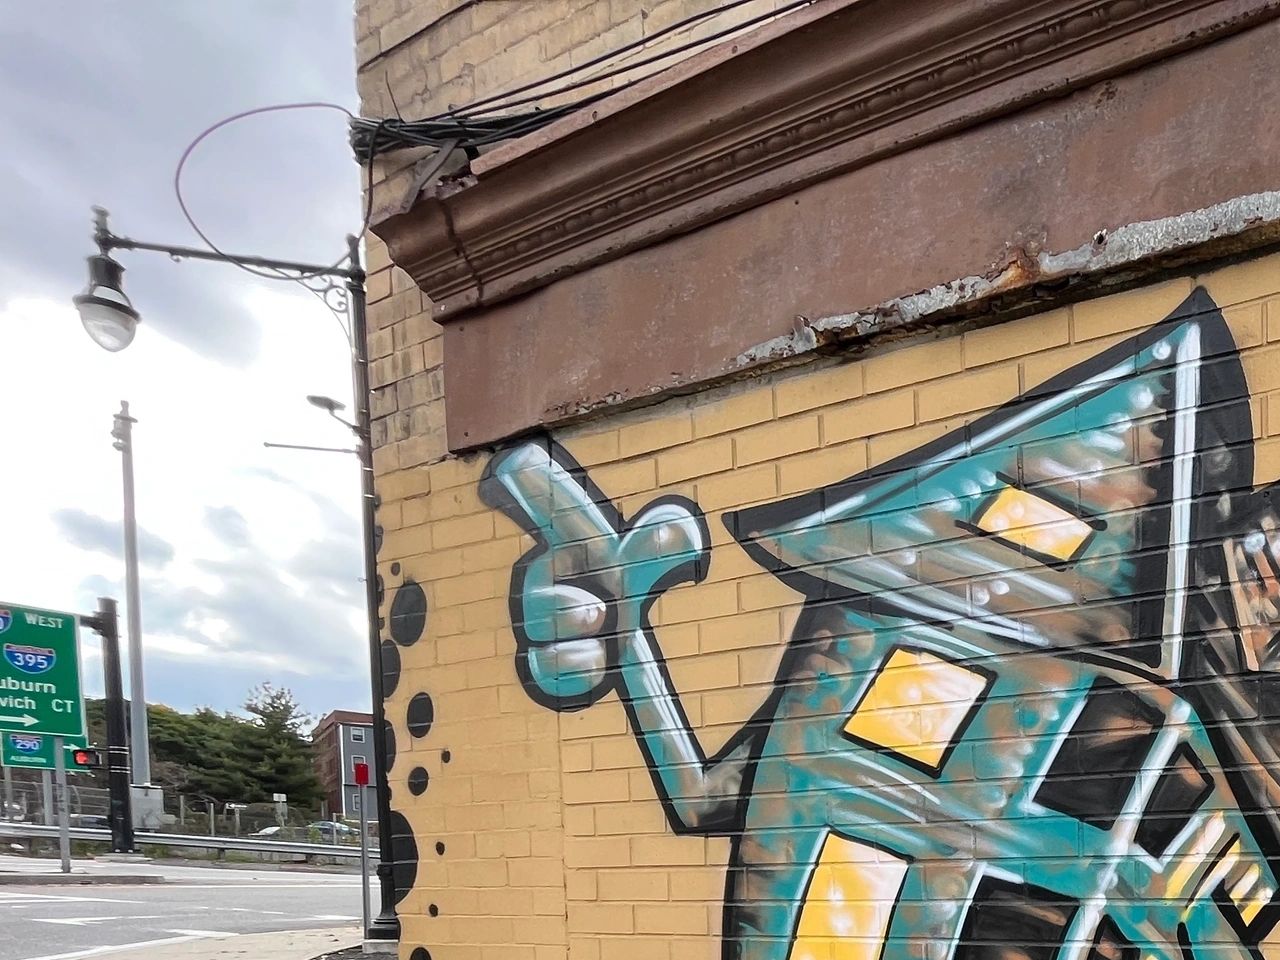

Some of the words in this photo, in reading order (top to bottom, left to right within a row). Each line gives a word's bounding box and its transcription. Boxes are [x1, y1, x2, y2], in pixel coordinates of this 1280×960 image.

[24, 612, 63, 629] WEST
[13, 652, 48, 669] 395
[51, 699, 74, 713] CT
